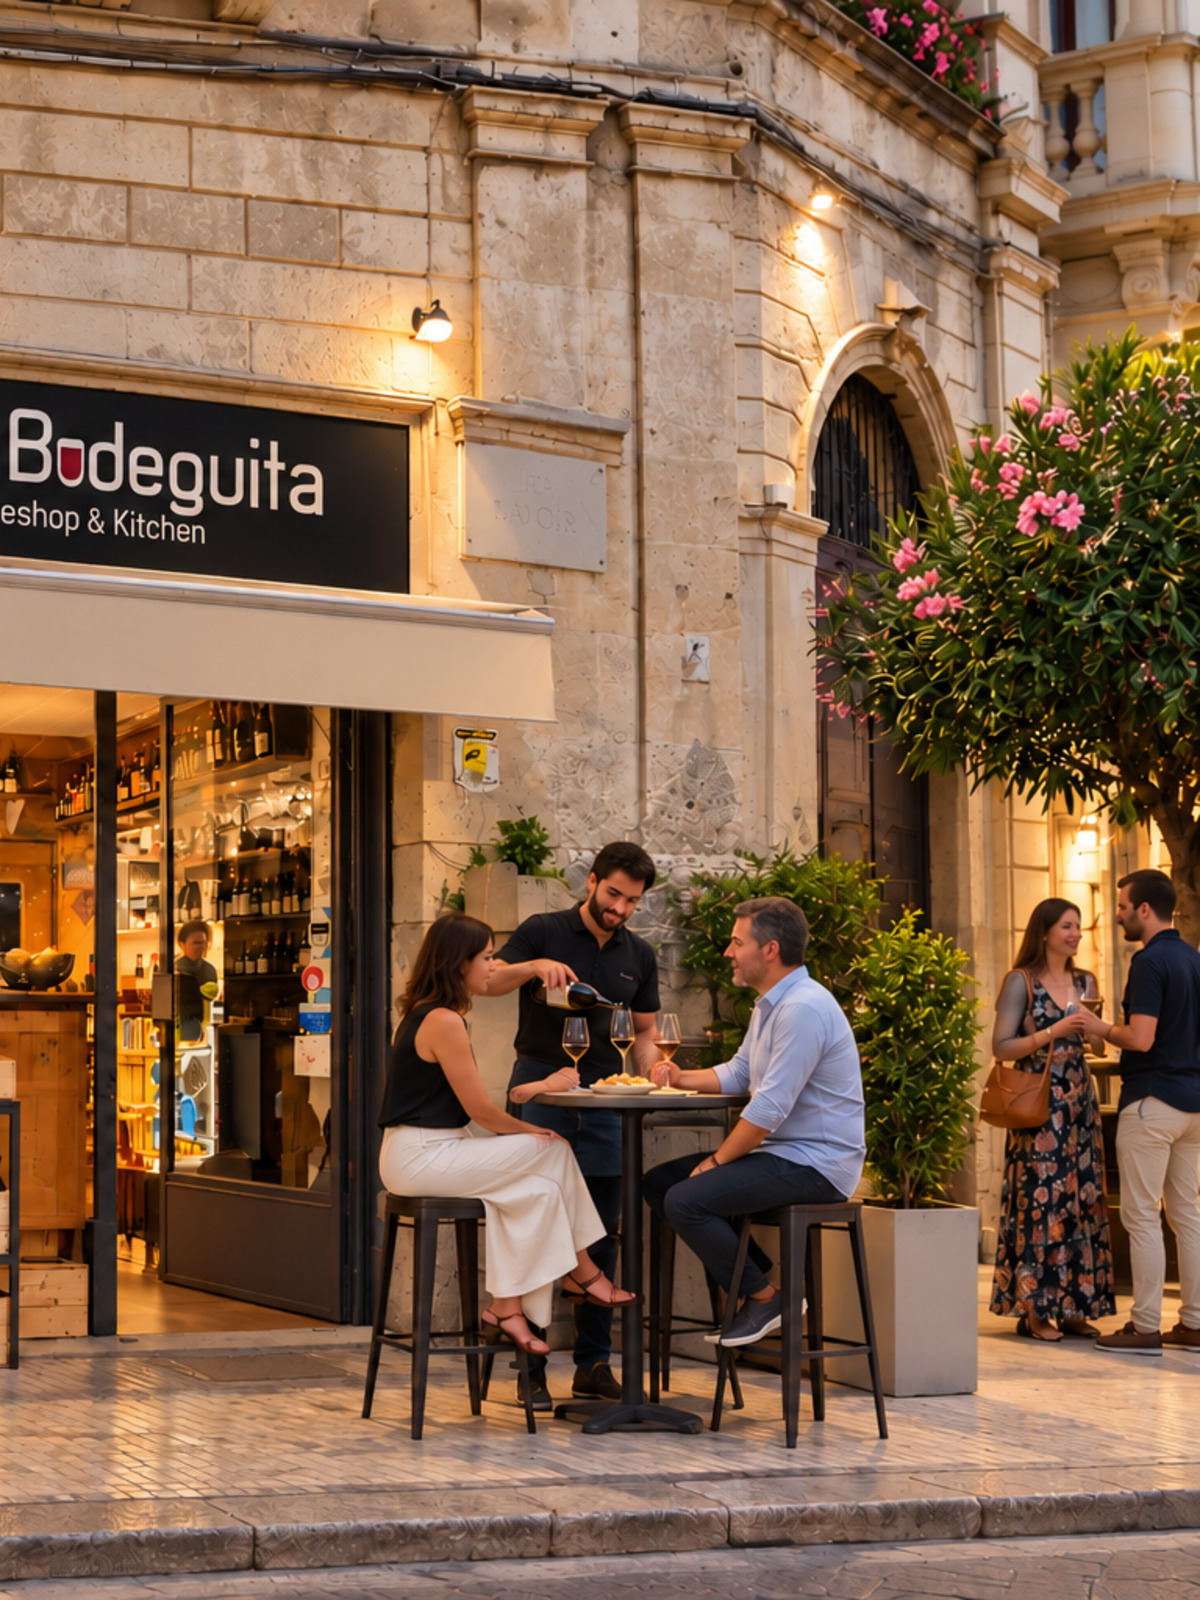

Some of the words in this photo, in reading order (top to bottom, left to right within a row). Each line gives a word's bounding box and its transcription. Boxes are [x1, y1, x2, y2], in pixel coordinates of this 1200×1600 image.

[8, 407, 324, 517] Bodeguita
[87, 507, 106, 534] &
[113, 508, 207, 545] Kitchen
